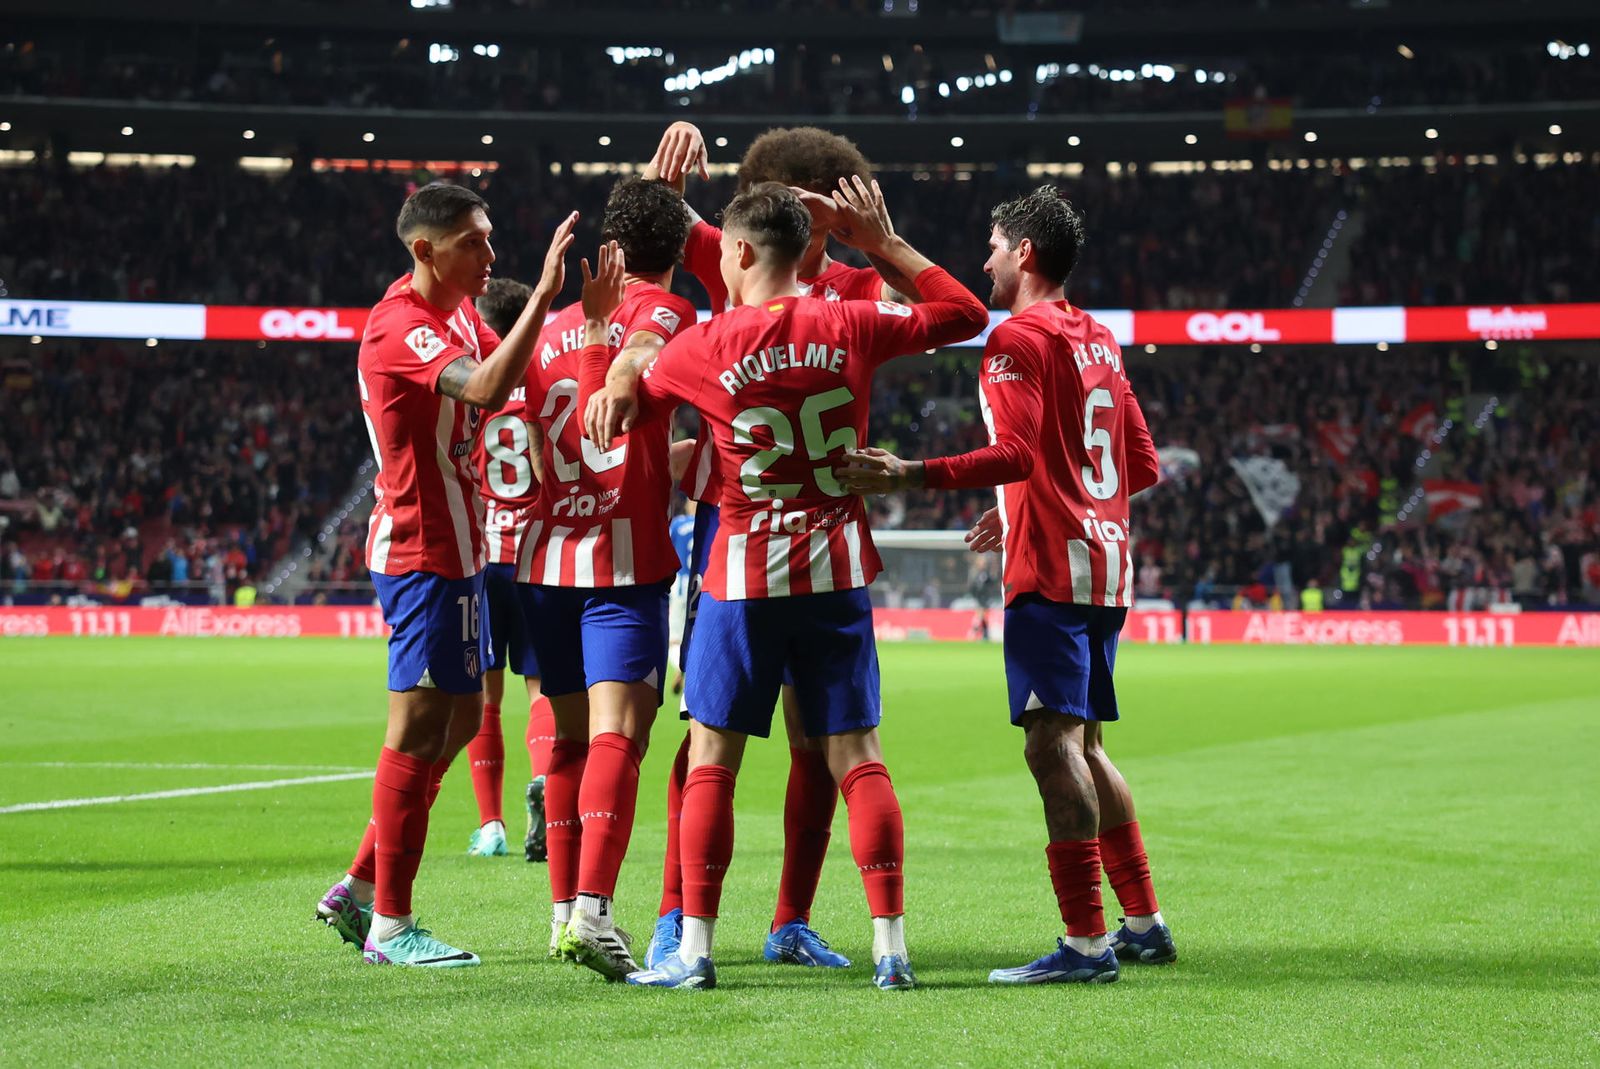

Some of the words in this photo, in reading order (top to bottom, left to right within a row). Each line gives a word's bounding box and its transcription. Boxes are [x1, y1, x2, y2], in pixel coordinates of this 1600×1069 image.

[259, 310, 354, 339] GOL
[1186, 313, 1280, 342] GOL
[718, 343, 847, 396] RIQUELME
[988, 372, 1023, 384] YUNDAI
[1090, 343, 1125, 381] PAU
[484, 415, 531, 498] 8
[731, 386, 858, 503] 25
[1082, 388, 1119, 500] 5
[485, 499, 514, 528] ia
[552, 486, 596, 517] ria
[750, 499, 807, 534] ria
[1083, 508, 1126, 541] ria
[69, 611, 131, 637] 11.11
[162, 608, 301, 637] AliExpress
[337, 611, 384, 638] 11.1
[457, 593, 480, 642] 16
[1244, 613, 1403, 645] AliExpress
[1443, 617, 1515, 646] 11.11
